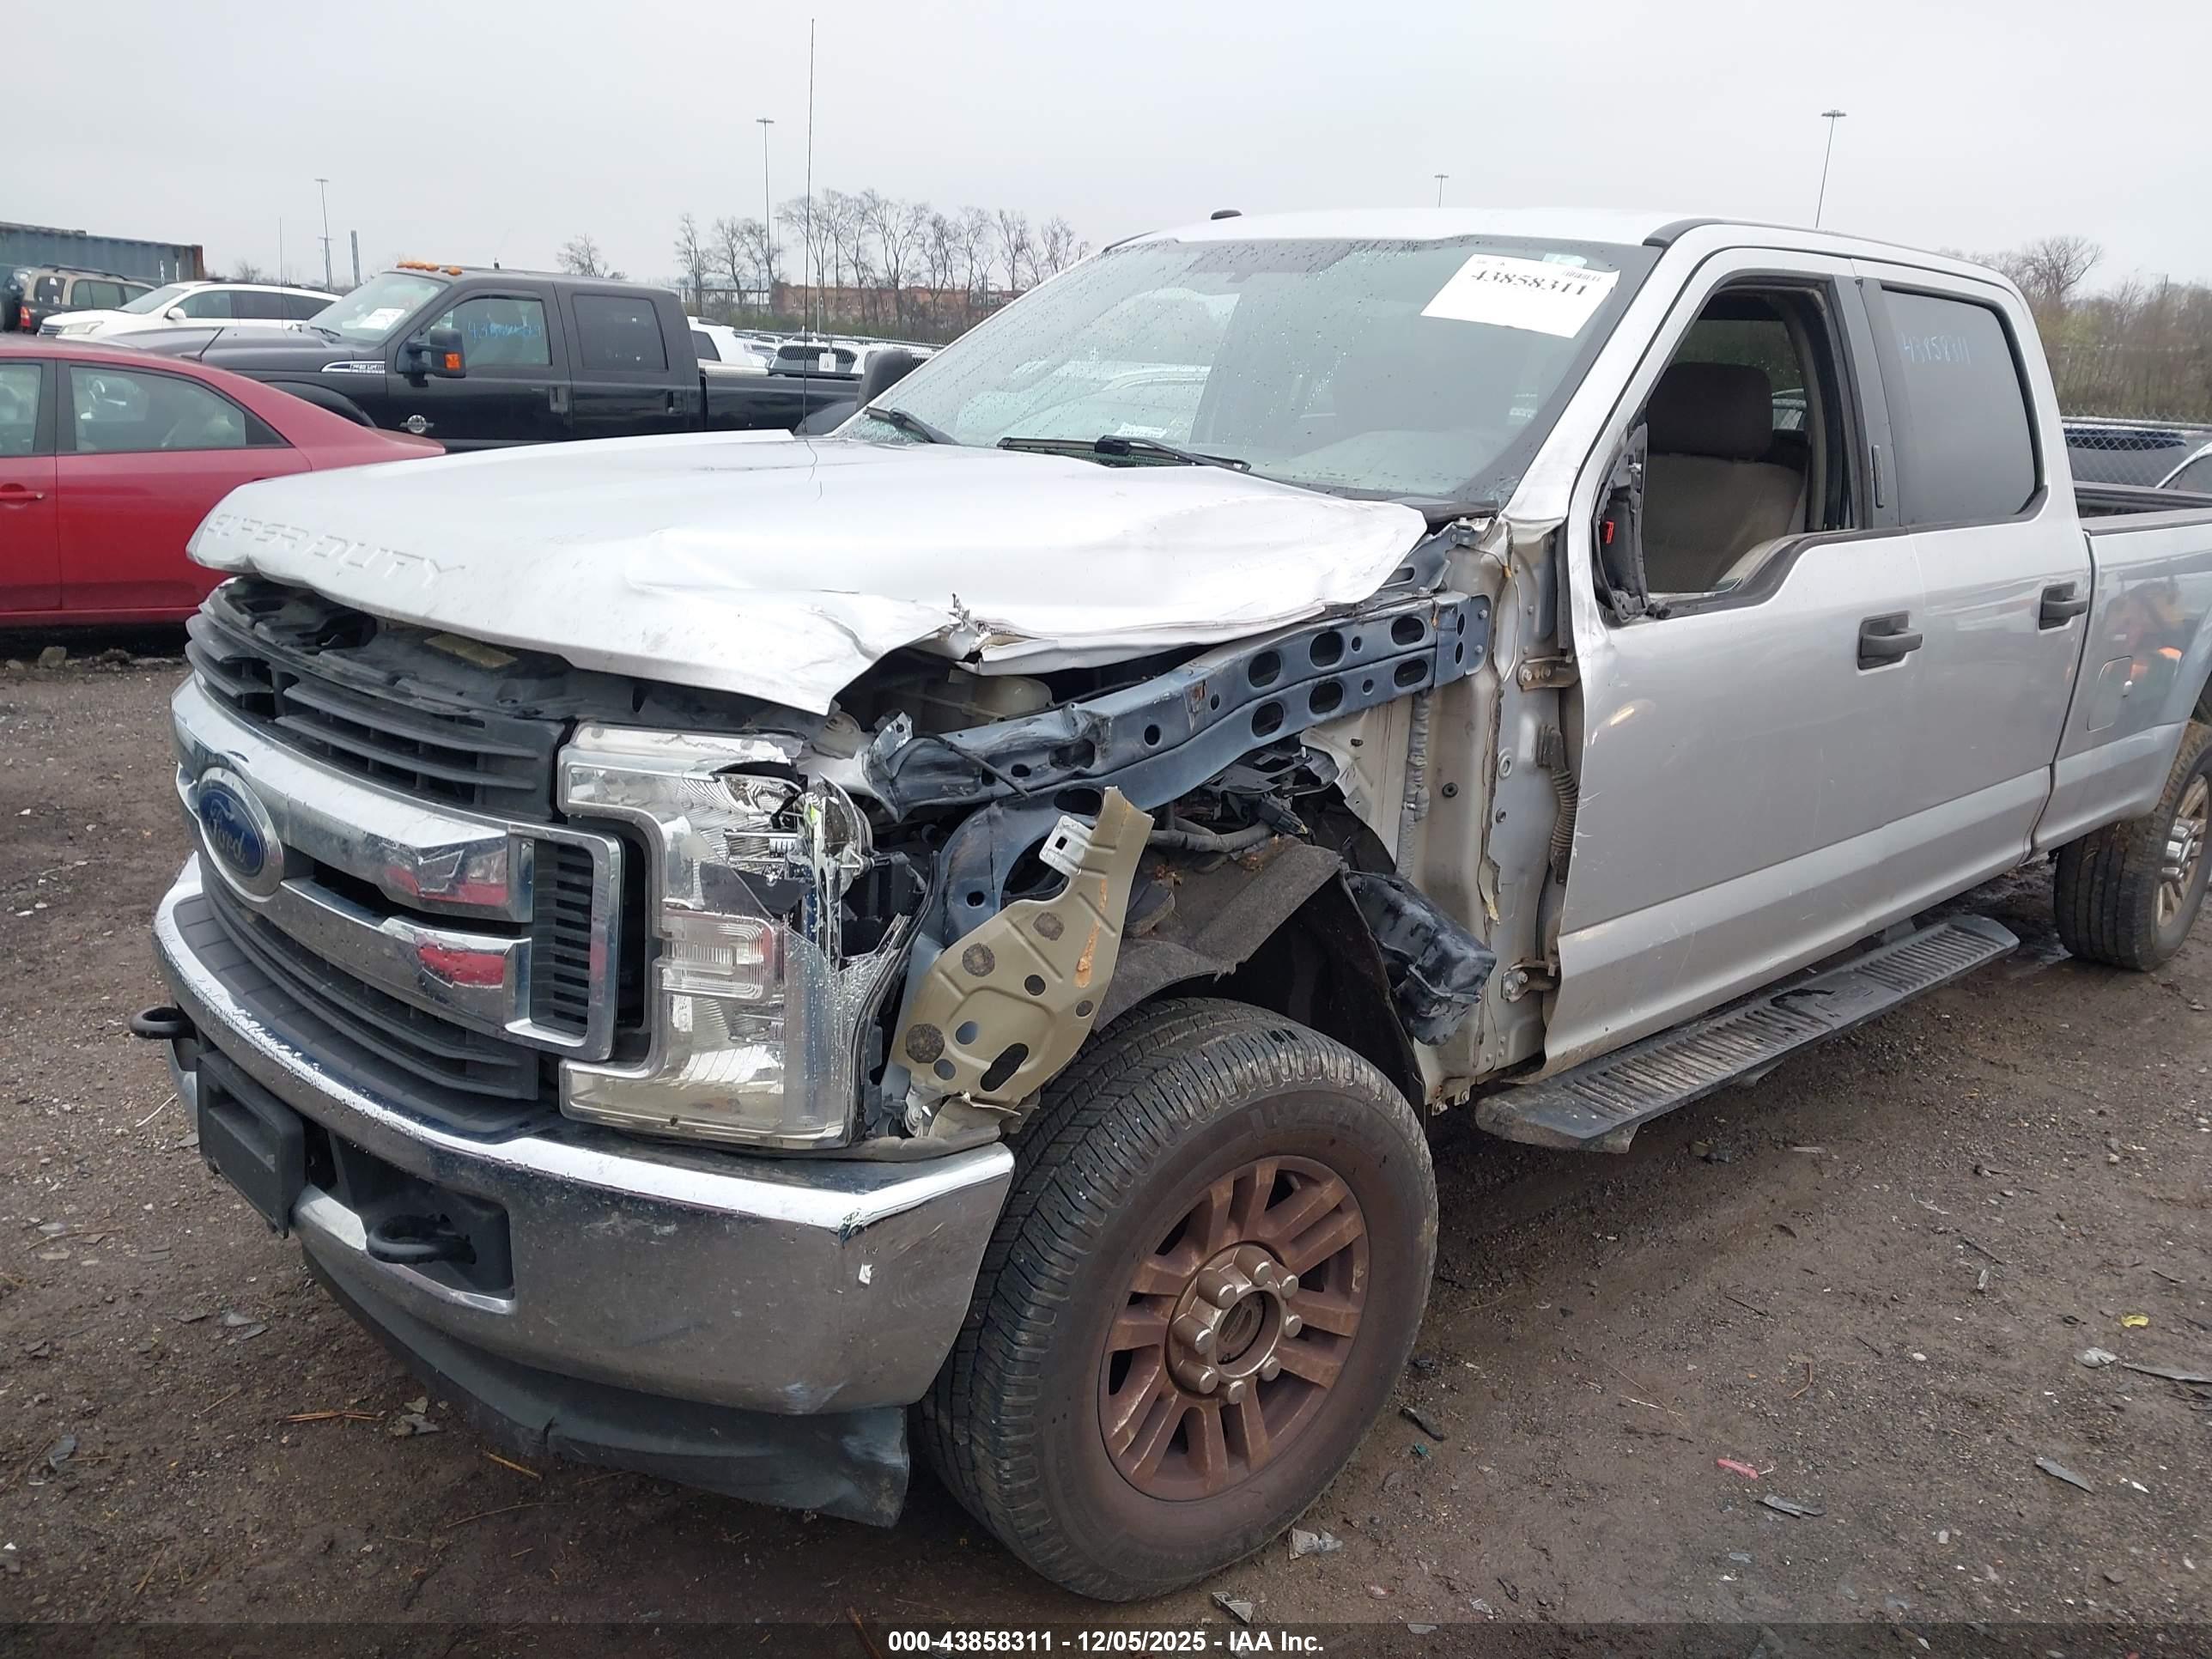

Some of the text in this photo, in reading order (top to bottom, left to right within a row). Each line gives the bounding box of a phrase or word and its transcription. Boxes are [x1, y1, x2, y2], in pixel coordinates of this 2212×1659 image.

[1471, 270, 1588, 295] 43858311
[207, 514, 466, 588] SUPER DUTY
[209, 798, 247, 864] Ford
